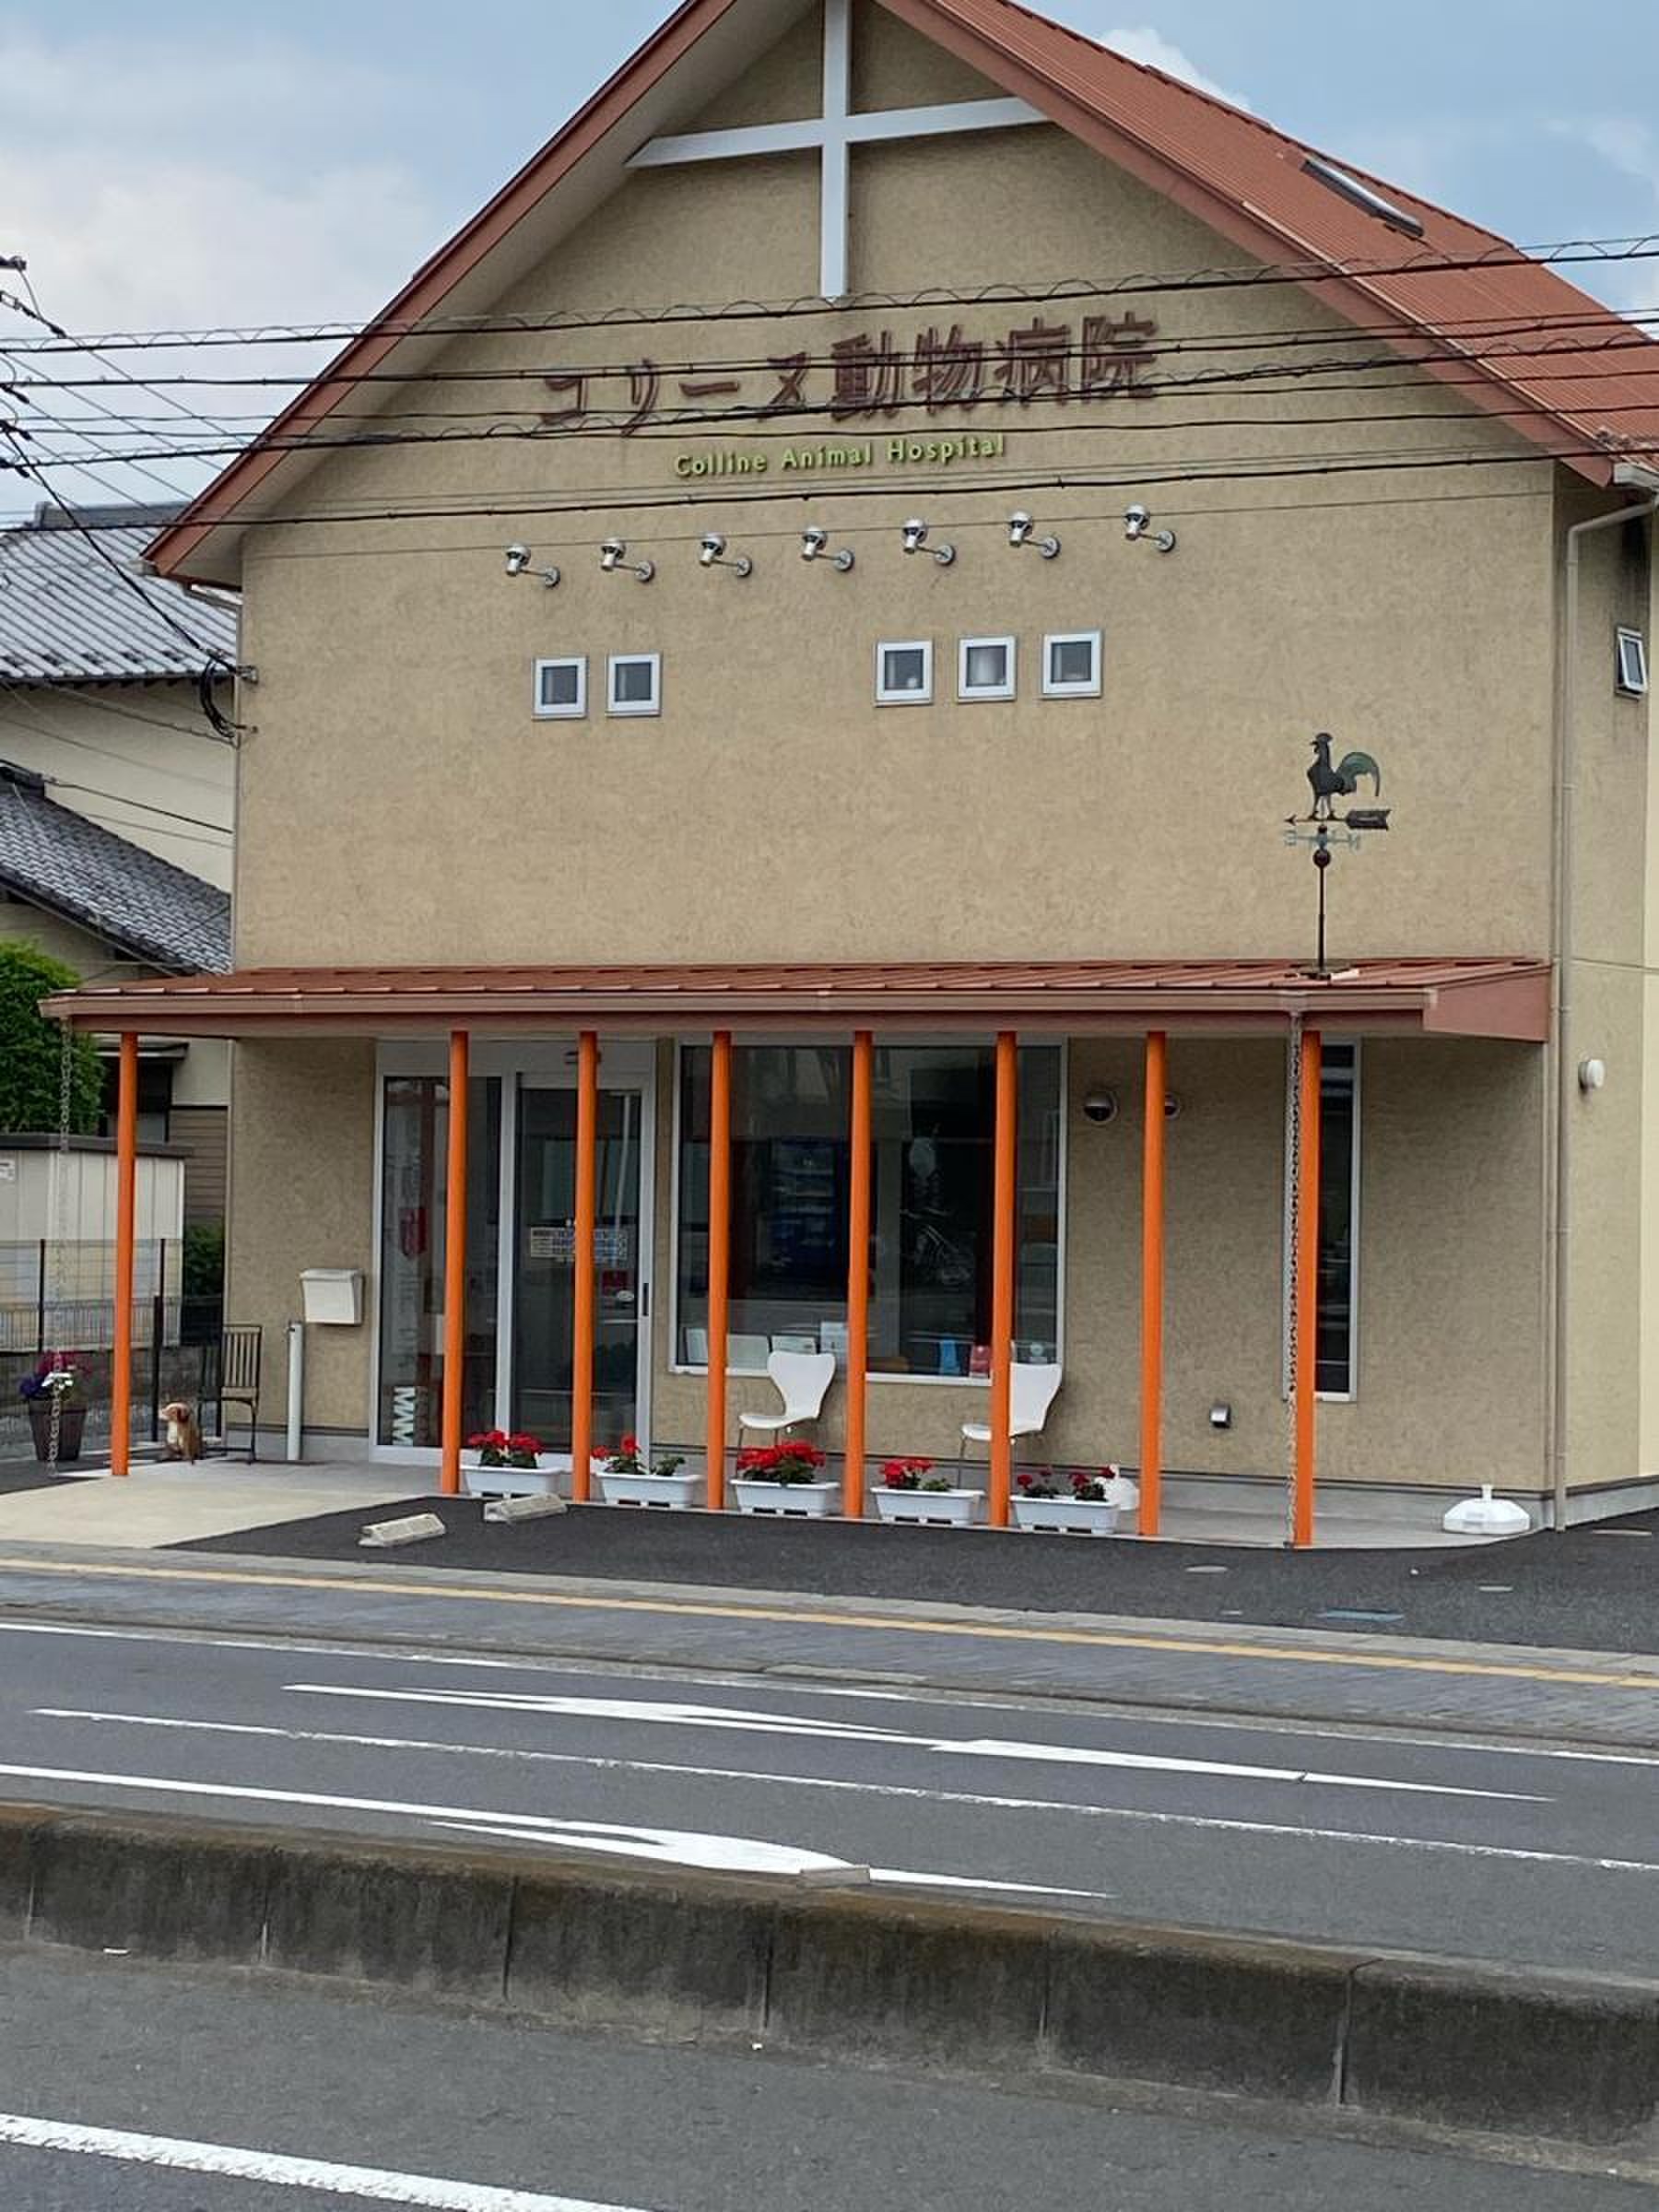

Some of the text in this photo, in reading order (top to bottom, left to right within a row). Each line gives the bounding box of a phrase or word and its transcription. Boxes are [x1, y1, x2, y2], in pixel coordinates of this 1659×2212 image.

[540, 312, 1158, 437] コリーヌ動物病院
[677, 433, 1006, 477] Colline Animal Hospital
